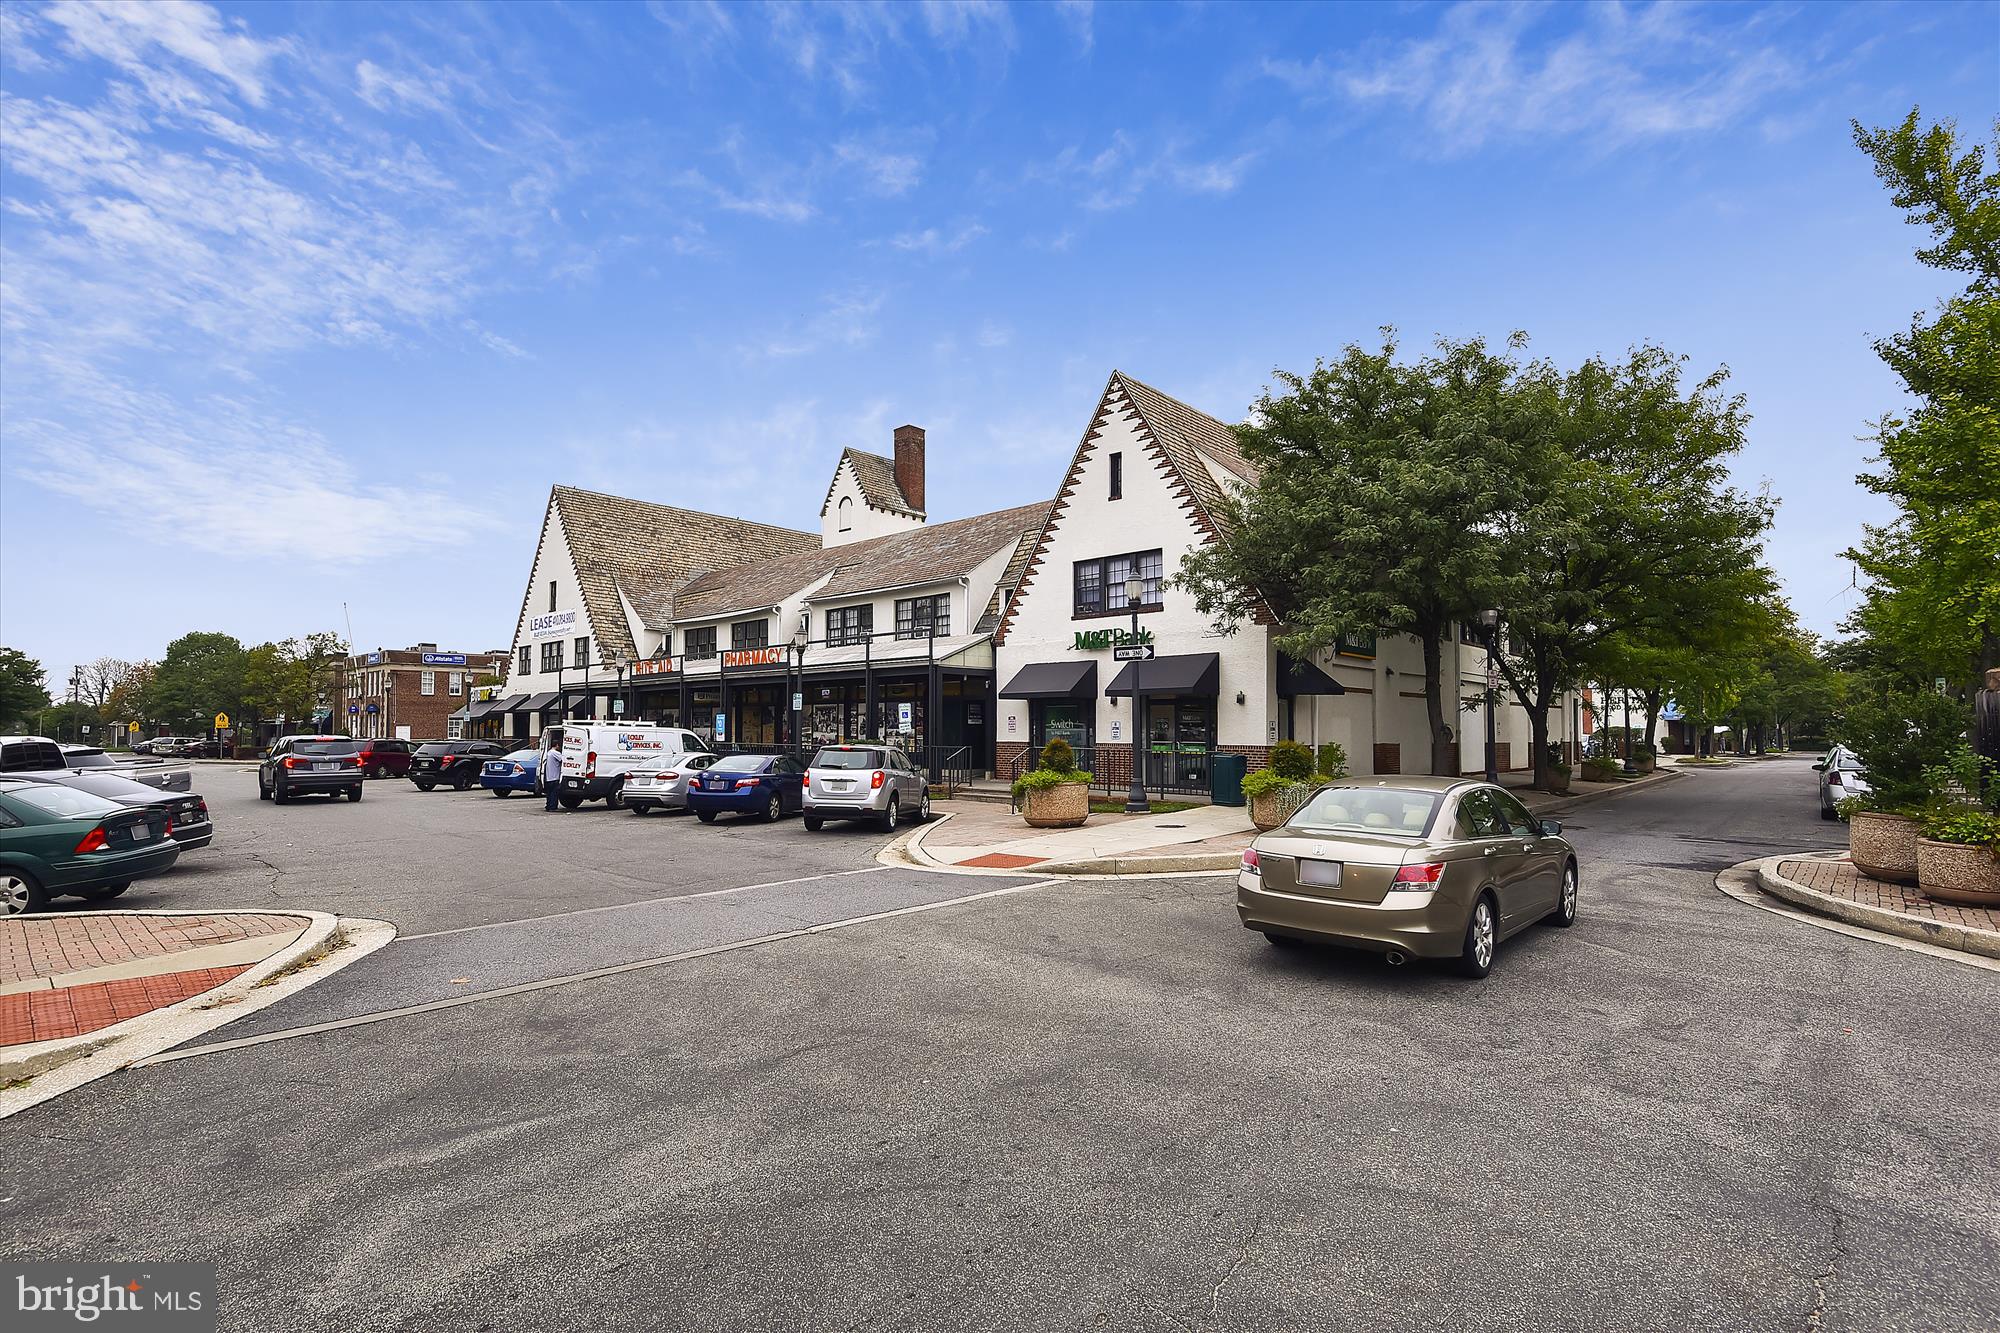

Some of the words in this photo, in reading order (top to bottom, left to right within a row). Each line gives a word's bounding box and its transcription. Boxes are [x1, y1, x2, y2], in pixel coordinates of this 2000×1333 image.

[530, 615, 553, 631] LEASE
[1074, 630, 1113, 650] M&T
[635, 660, 654, 675] RITE
[657, 657, 673, 673] AID
[724, 648, 783, 667] PHARMACY
[1050, 718, 1074, 729] Switch
